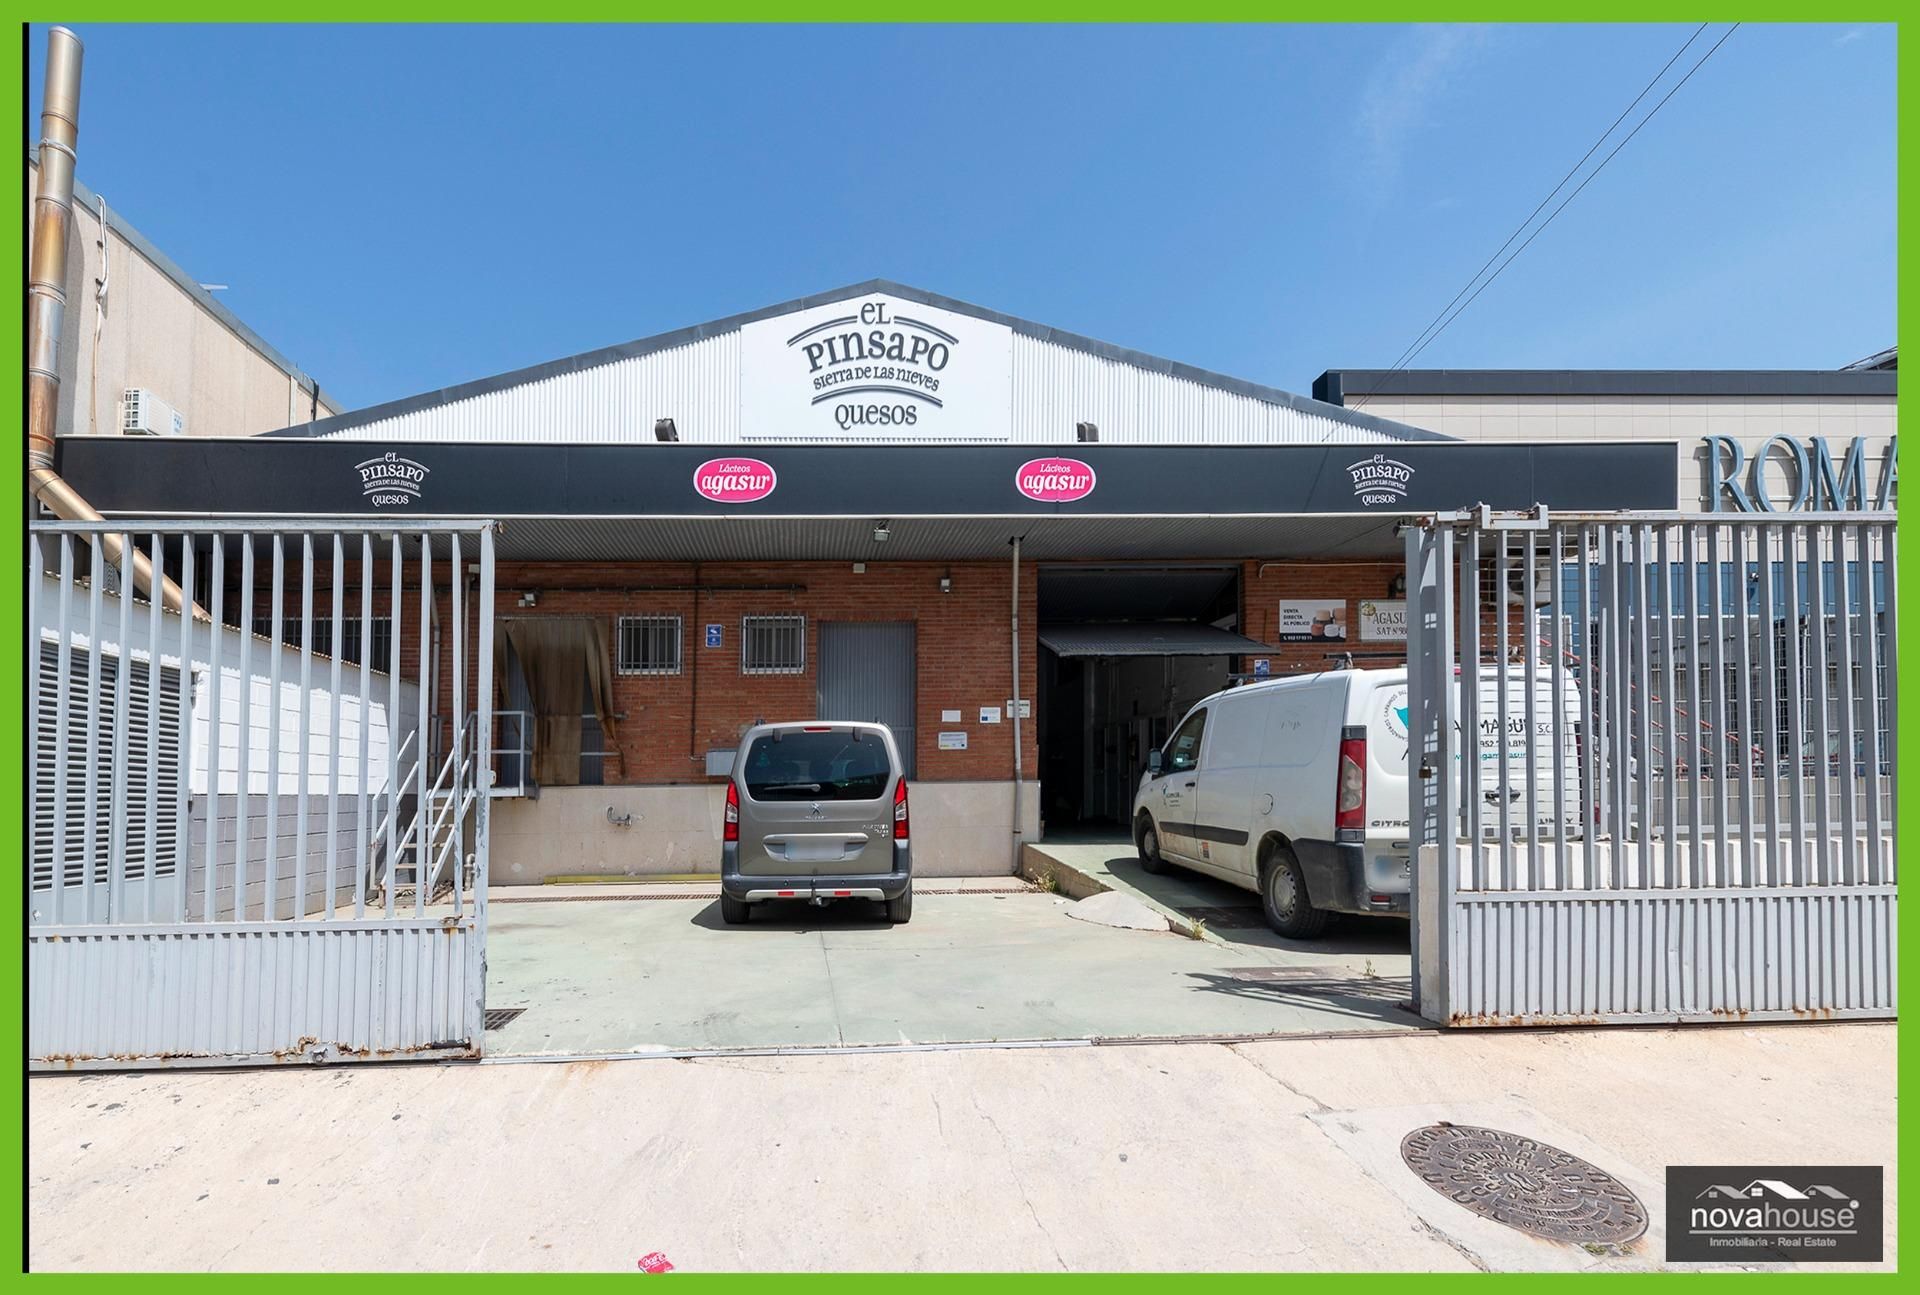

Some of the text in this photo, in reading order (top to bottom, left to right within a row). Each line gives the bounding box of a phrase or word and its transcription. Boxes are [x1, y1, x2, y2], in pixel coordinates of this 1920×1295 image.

[719, 463, 751, 473] Lácteos
[1039, 463, 1071, 473] Lácteos
[701, 474, 770, 495] agasur
[1023, 474, 1090, 495] agasur
[1372, 611, 1407, 625] AGASU
[1376, 627, 1391, 636] SAT
